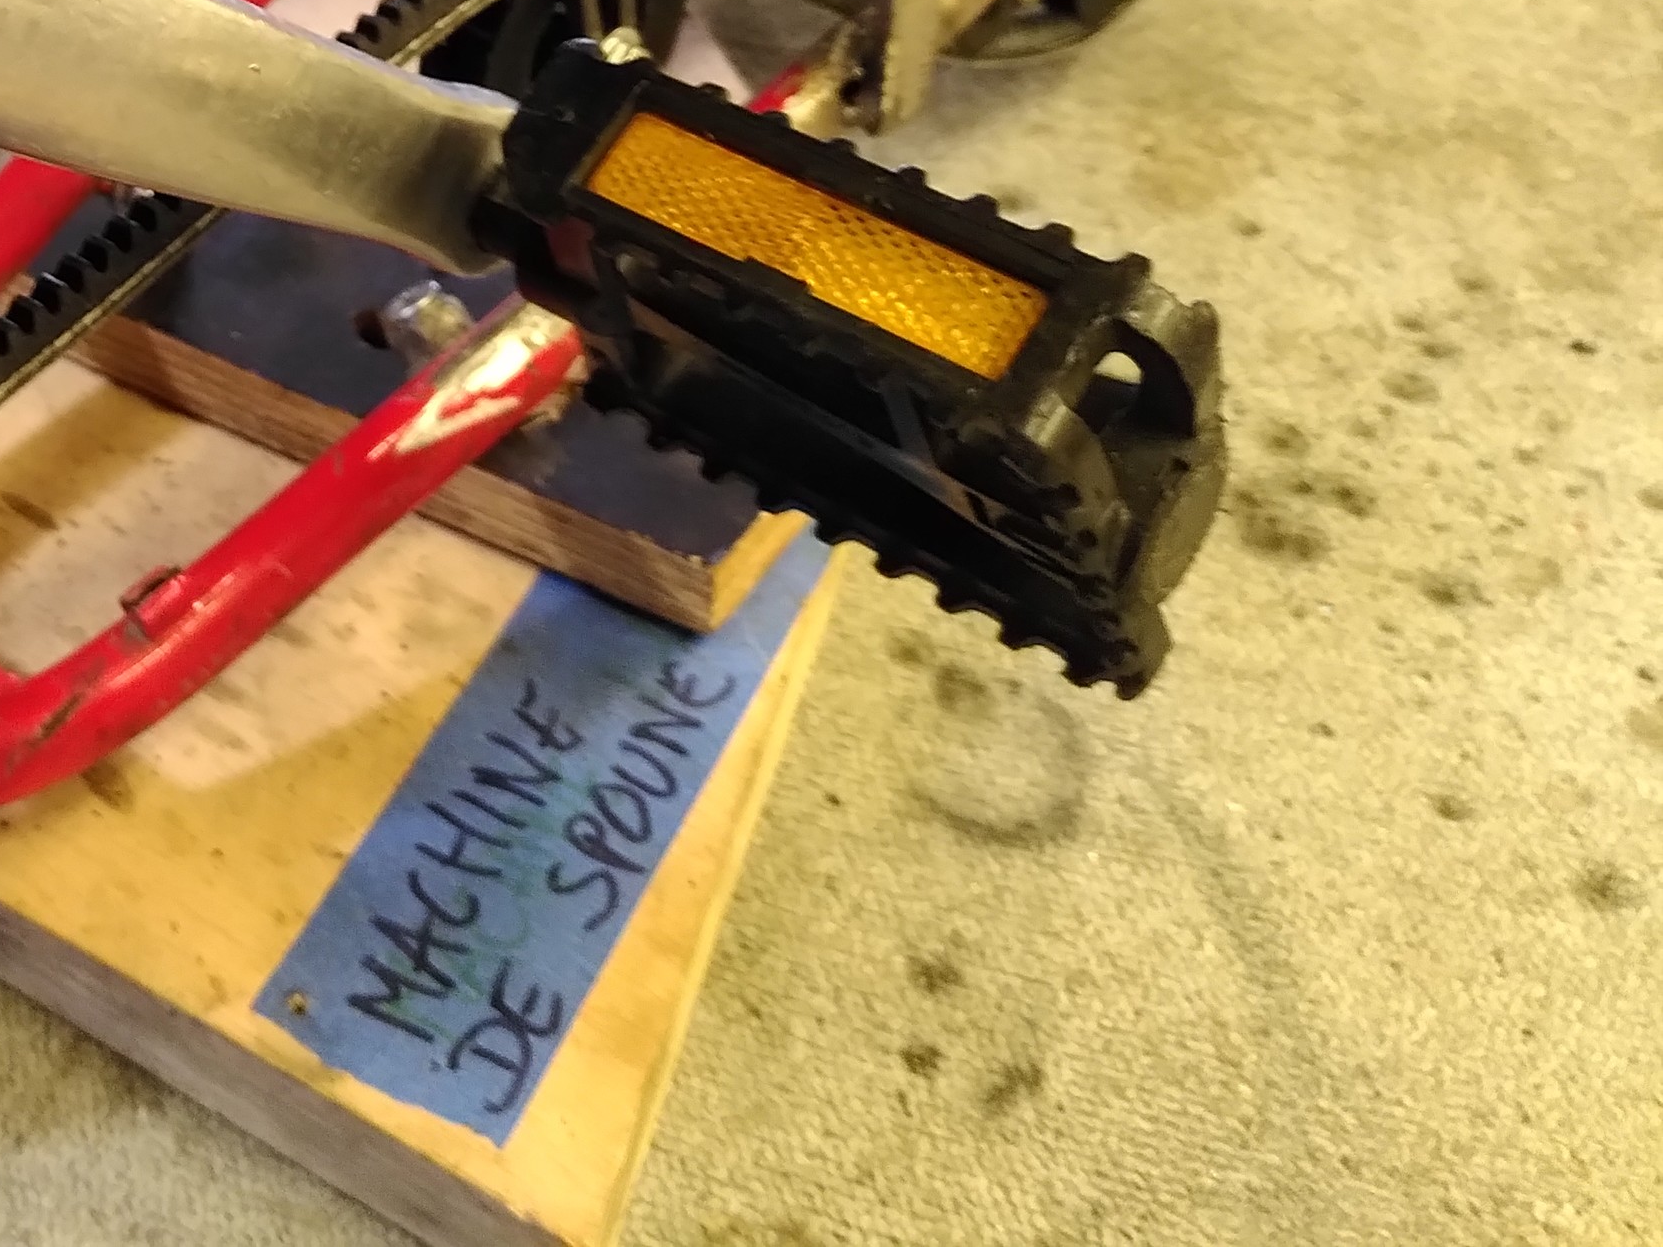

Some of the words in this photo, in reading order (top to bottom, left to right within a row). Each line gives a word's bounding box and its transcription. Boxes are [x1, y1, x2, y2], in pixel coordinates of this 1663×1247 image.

[347, 679, 583, 1042] MACHINE
[446, 958, 563, 1114] DE
[548, 658, 735, 932] SPOUNE
